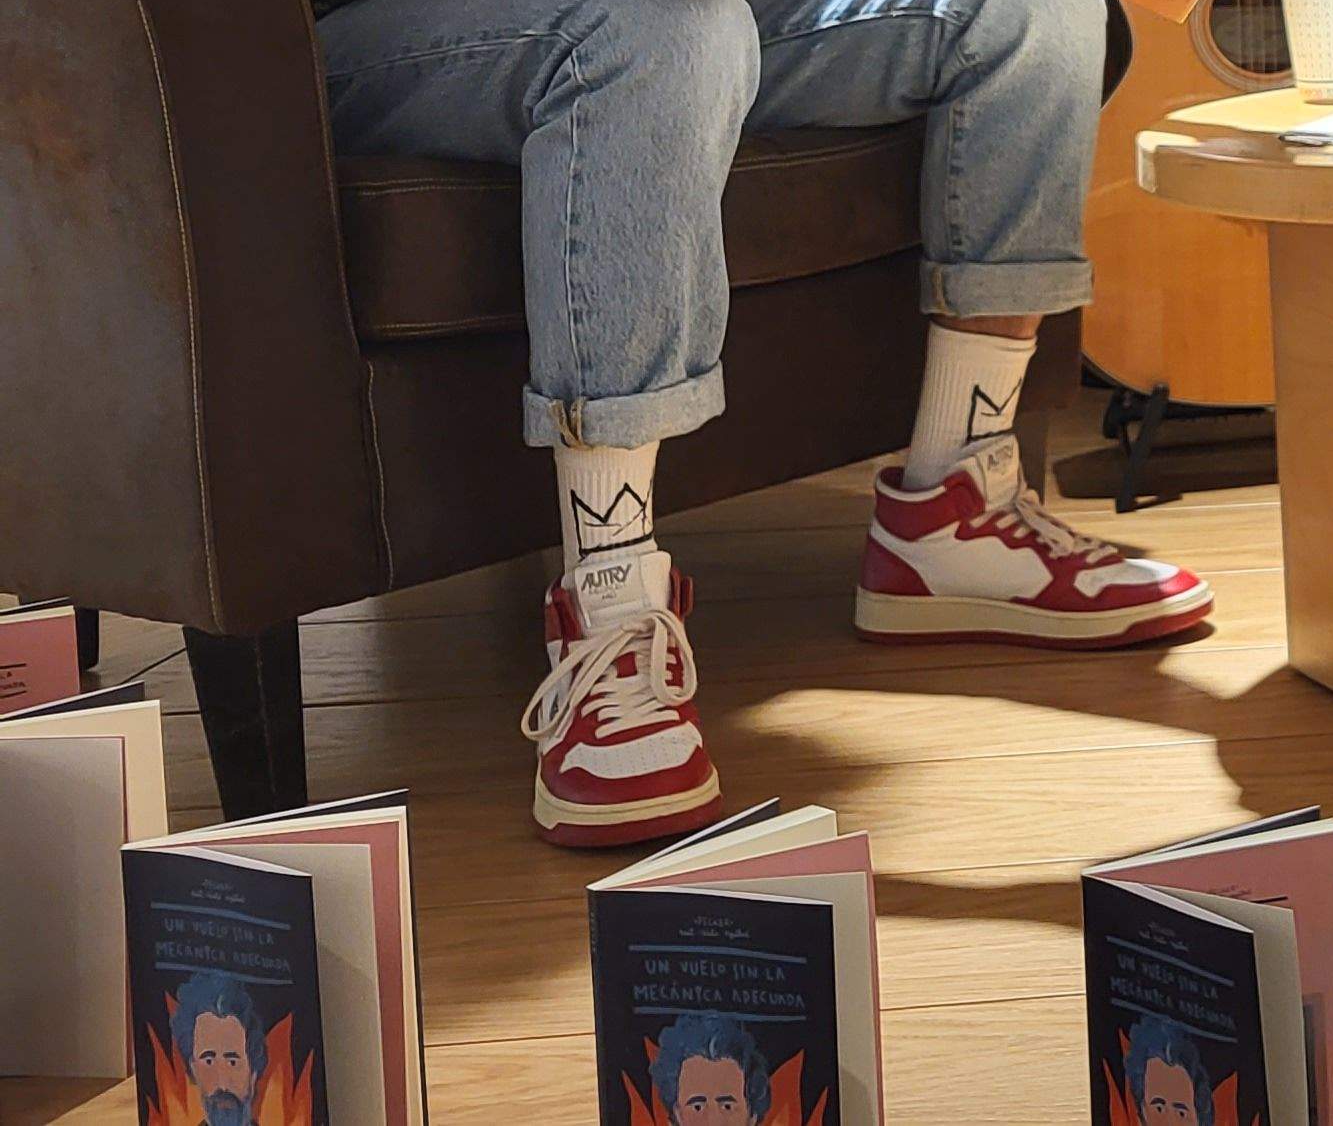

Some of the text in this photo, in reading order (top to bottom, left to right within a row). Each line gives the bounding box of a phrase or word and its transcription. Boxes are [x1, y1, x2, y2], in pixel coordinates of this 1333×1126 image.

[581, 562, 633, 592] AUTRY
[644, 958, 670, 975] UN
[678, 960, 727, 978] VUELO
[766, 966, 787, 981] LA
